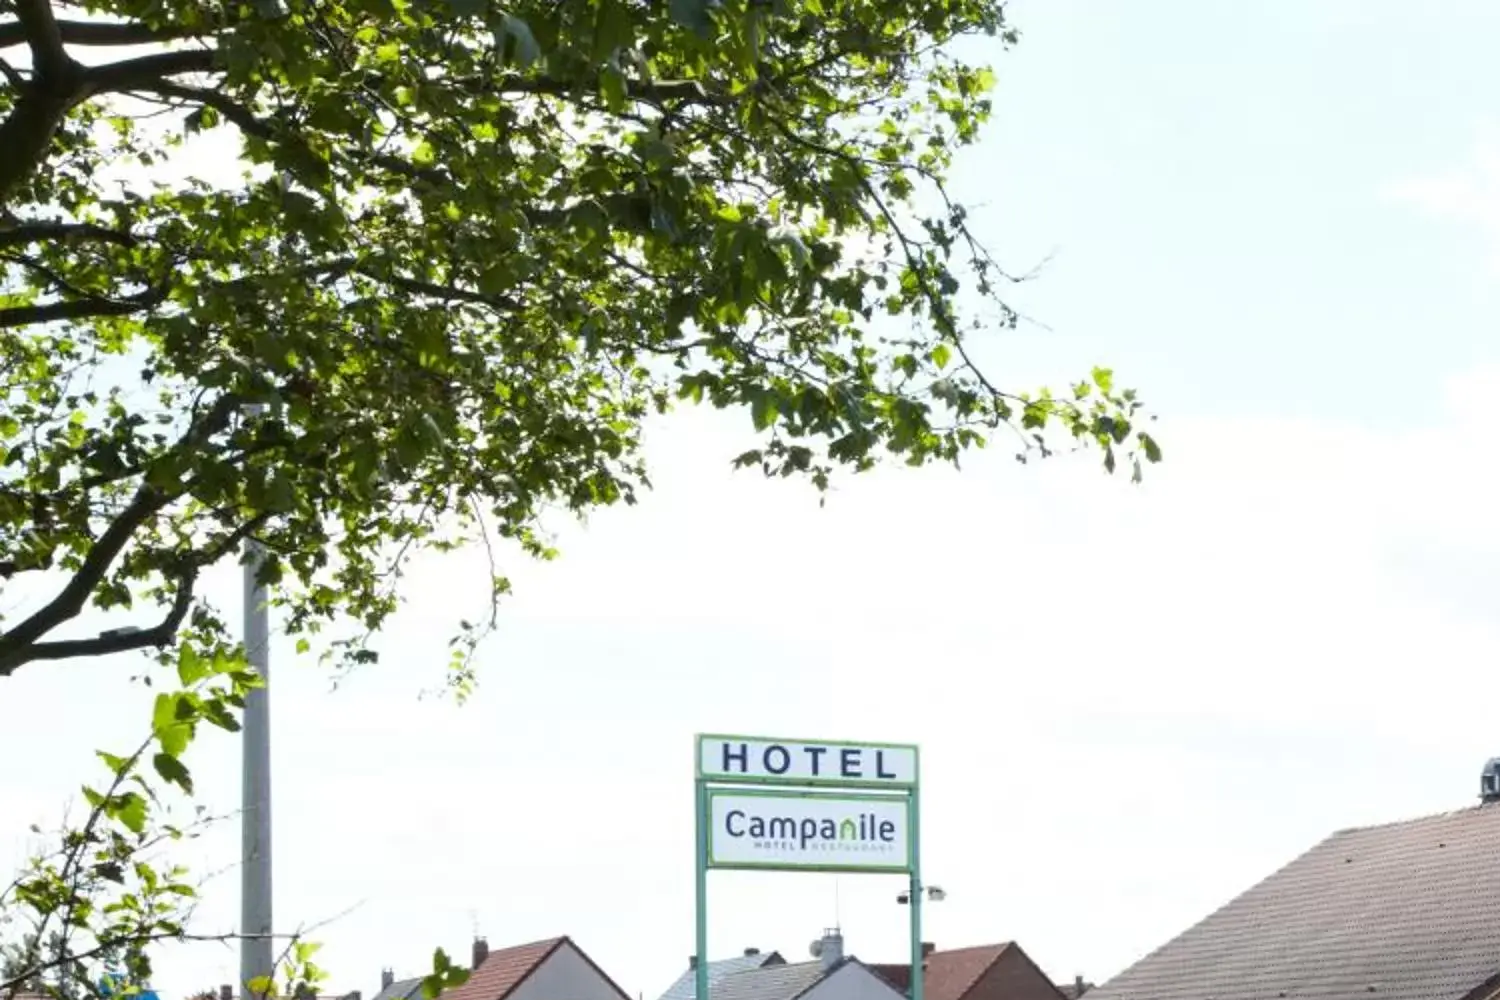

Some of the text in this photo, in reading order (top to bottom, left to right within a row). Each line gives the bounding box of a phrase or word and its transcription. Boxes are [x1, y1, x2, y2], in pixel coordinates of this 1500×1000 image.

[722, 743, 897, 779] HOTEL
[725, 810, 895, 850] Campanile
[754, 841, 796, 850] HOTEL
